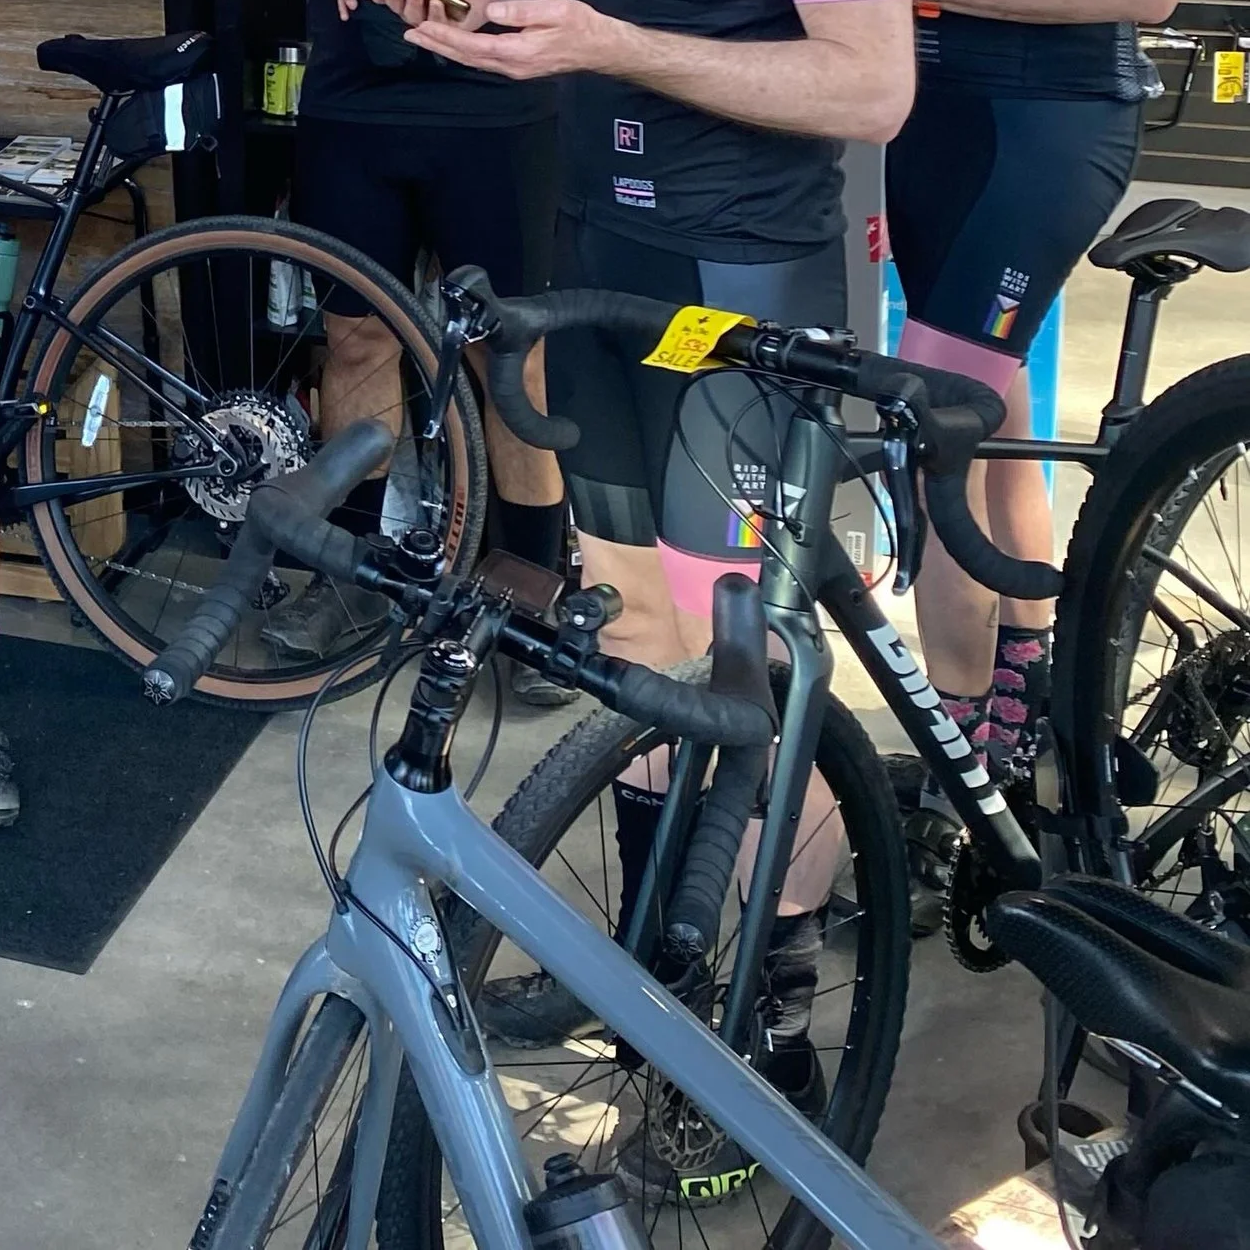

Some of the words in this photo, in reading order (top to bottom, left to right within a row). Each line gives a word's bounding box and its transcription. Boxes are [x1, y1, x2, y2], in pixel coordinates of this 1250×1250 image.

[1002, 273, 1029, 288] WITH
[1004, 266, 1031, 282] RIDE
[652, 350, 700, 368] SALE
[733, 463, 767, 473] RIDE
[735, 473, 767, 481] WITH
